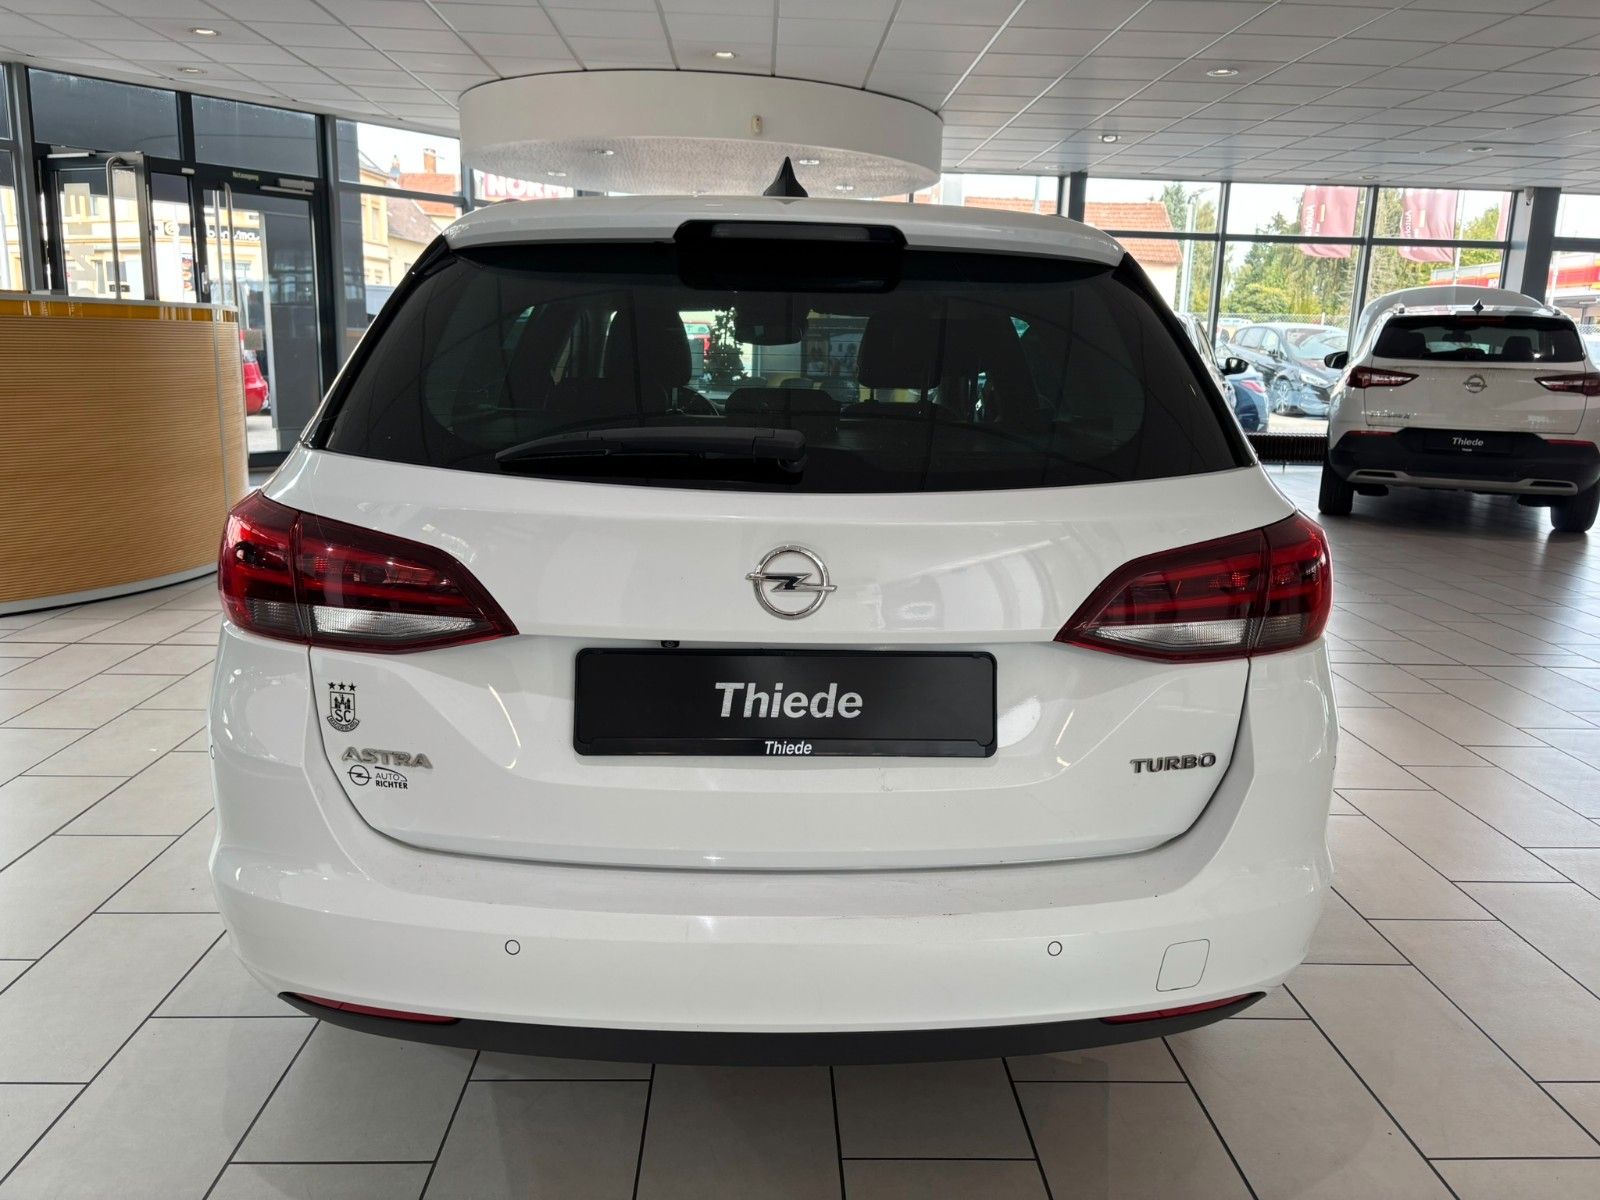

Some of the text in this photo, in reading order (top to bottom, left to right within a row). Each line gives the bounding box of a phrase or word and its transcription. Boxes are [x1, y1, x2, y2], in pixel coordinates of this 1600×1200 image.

[1452, 437, 1484, 447] Thiede
[714, 681, 864, 719] Thiede
[335, 709, 351, 723] SC
[764, 740, 813, 756] Thiede
[342, 746, 433, 769] ASTRA
[1130, 752, 1217, 773] TURBO
[375, 772, 400, 781] AUTO
[375, 780, 409, 790] RICHTER
